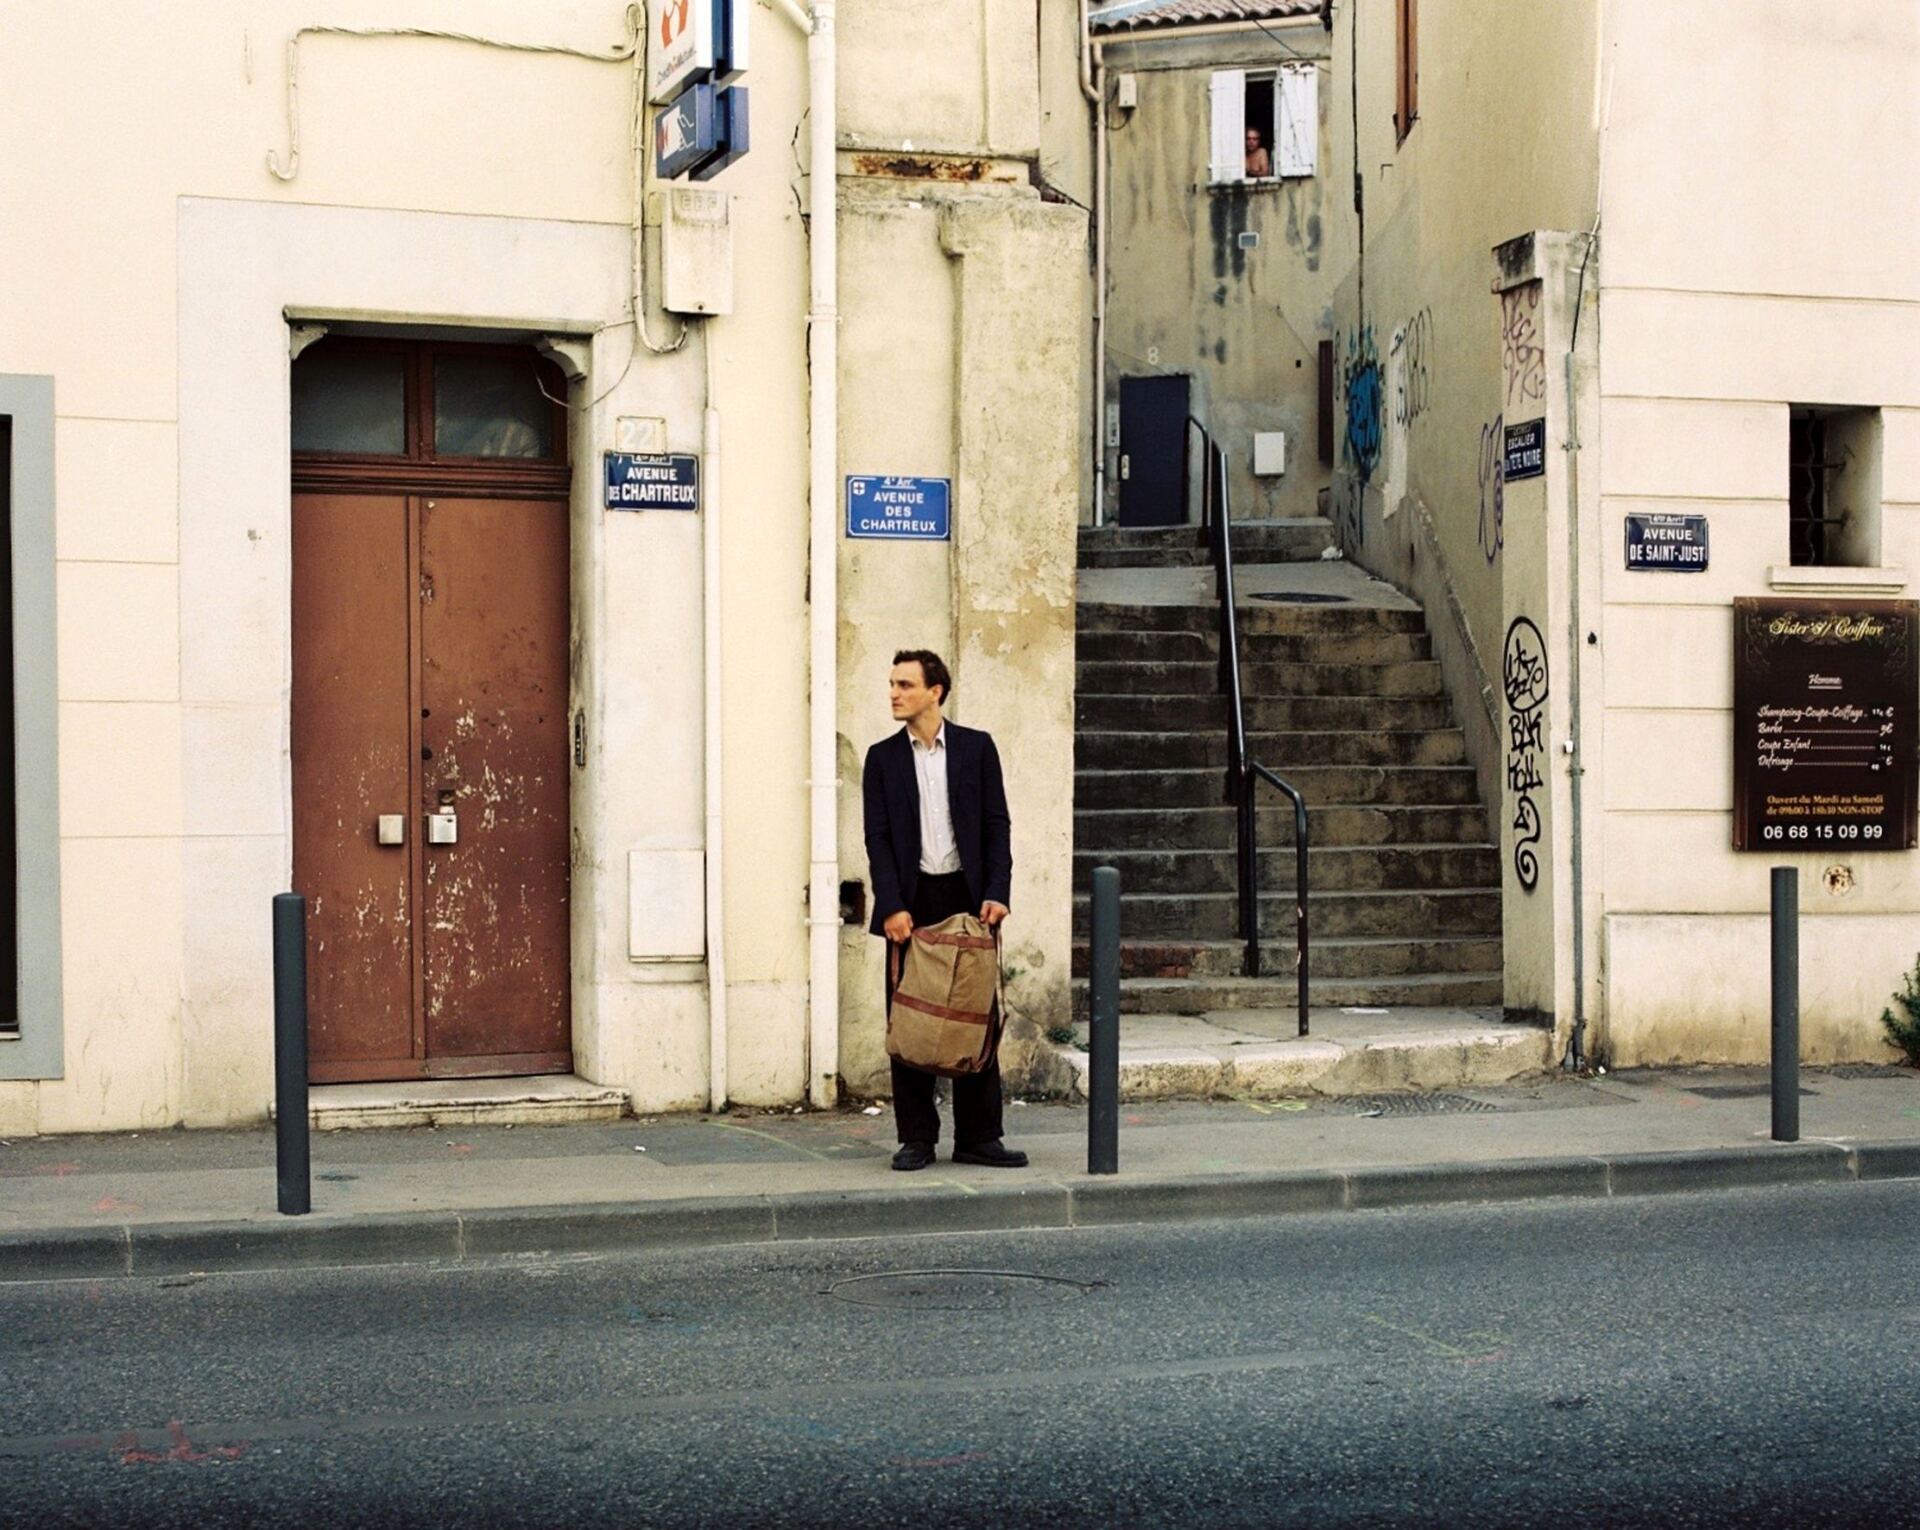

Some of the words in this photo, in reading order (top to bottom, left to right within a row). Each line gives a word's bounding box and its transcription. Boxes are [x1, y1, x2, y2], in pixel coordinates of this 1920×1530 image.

[1148, 346, 1158, 365] 8
[627, 467, 677, 481] AVENUE
[622, 483, 696, 502] CHARTREUX
[873, 492, 924, 504] AVENUE
[885, 506, 912, 518] DES
[861, 519, 936, 532] CHARTREUX
[1643, 528, 1693, 541] AVENUE
[1630, 544, 1643, 561] DE
[1646, 544, 1704, 562] SAINT-JUST
[1835, 616, 1884, 641] Coiffure
[1758, 721, 1782, 734] Barbe
[1758, 738, 1781, 754] Coupe
[1783, 737, 1811, 752] Enfant
[1767, 795, 1798, 804] Ouvert
[1799, 795, 1811, 804] du
[1813, 795, 1839, 804] Mardi
[1853, 795, 1883, 804] Samedi
[1767, 806, 1777, 815] de
[1838, 805, 1885, 815] NON-STOP
[1764, 825, 1783, 839] 06
[1788, 825, 1808, 839] 68
[1815, 825, 1833, 838] 15
[1838, 825, 1858, 838] 09
[1863, 825, 1883, 838] 99
